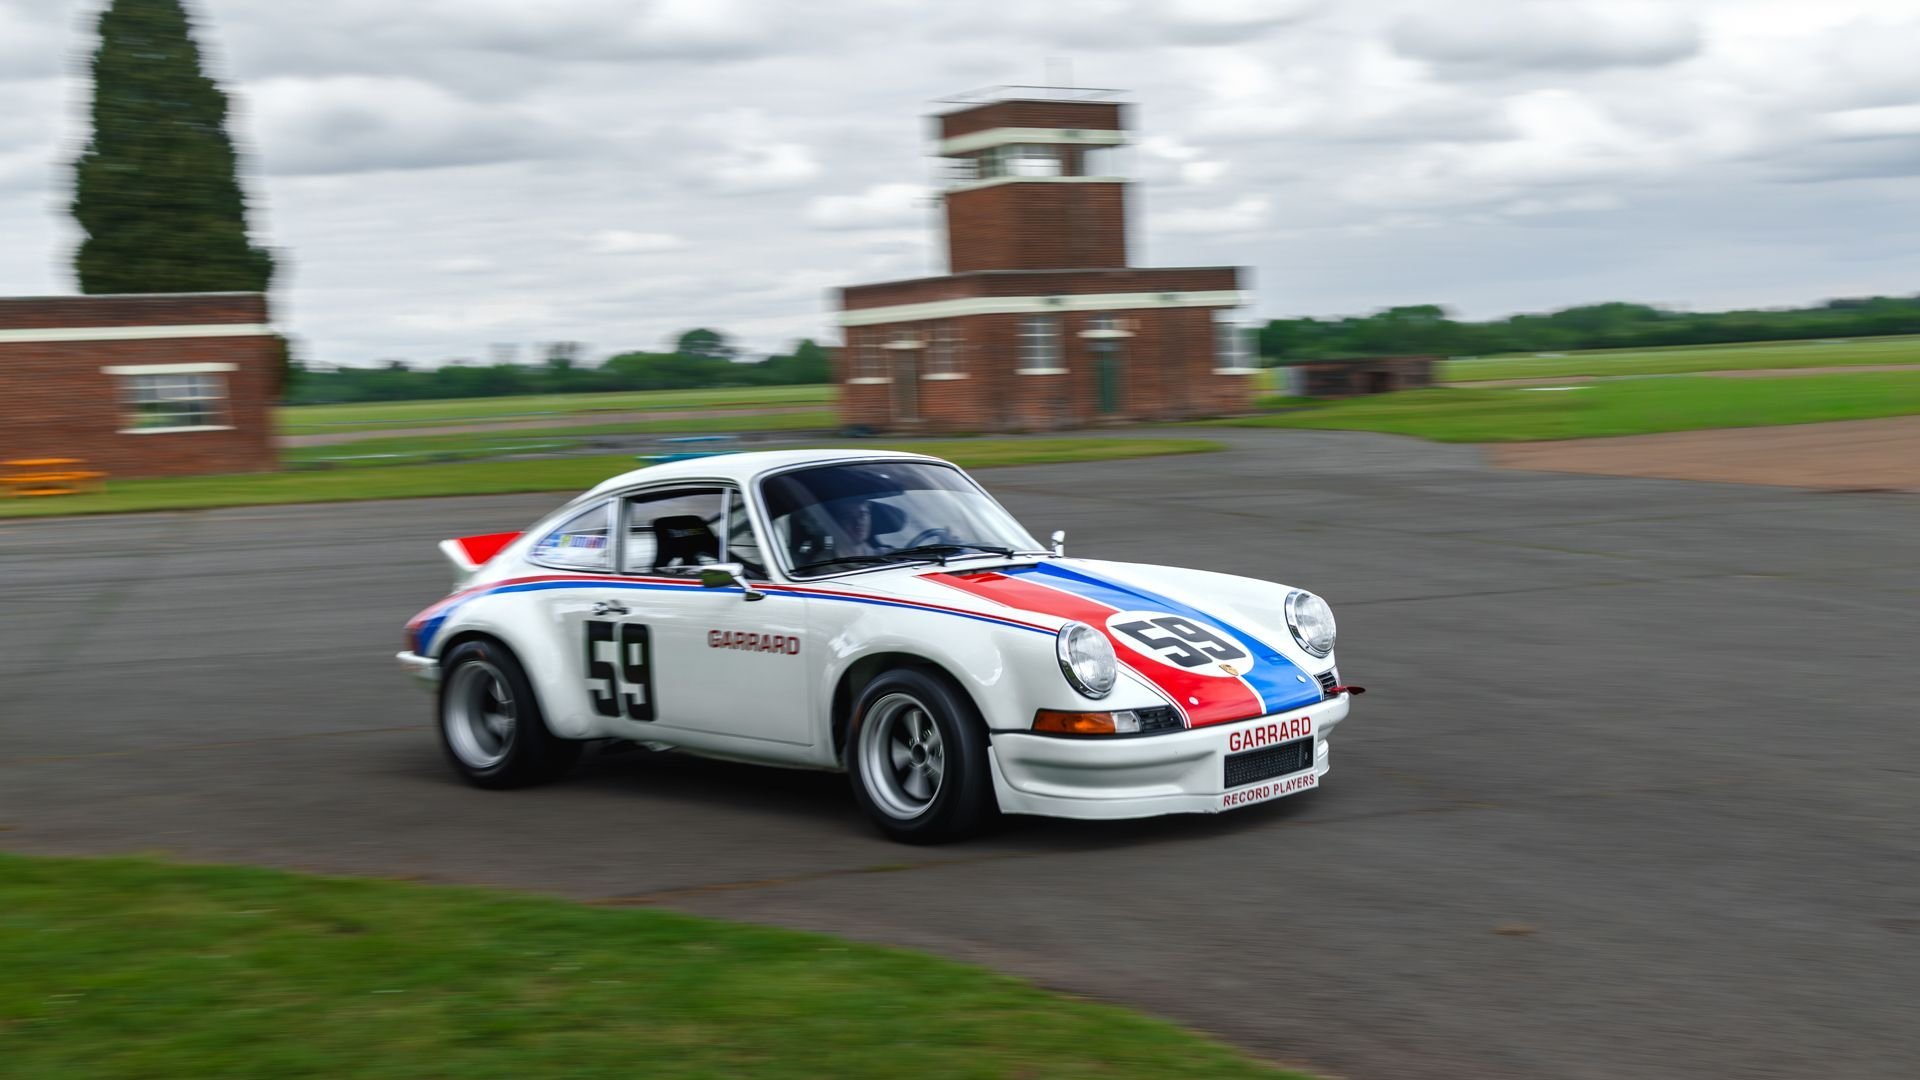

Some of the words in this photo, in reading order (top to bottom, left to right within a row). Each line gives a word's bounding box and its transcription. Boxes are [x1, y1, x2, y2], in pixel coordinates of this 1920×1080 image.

[708, 630, 800, 655] GARRARD
[1111, 616, 1247, 668] 59
[583, 620, 657, 722] 59
[1229, 716, 1311, 752] GARRARD
[1223, 785, 1270, 812] RECORD
[1273, 773, 1315, 796] PLAYERS
